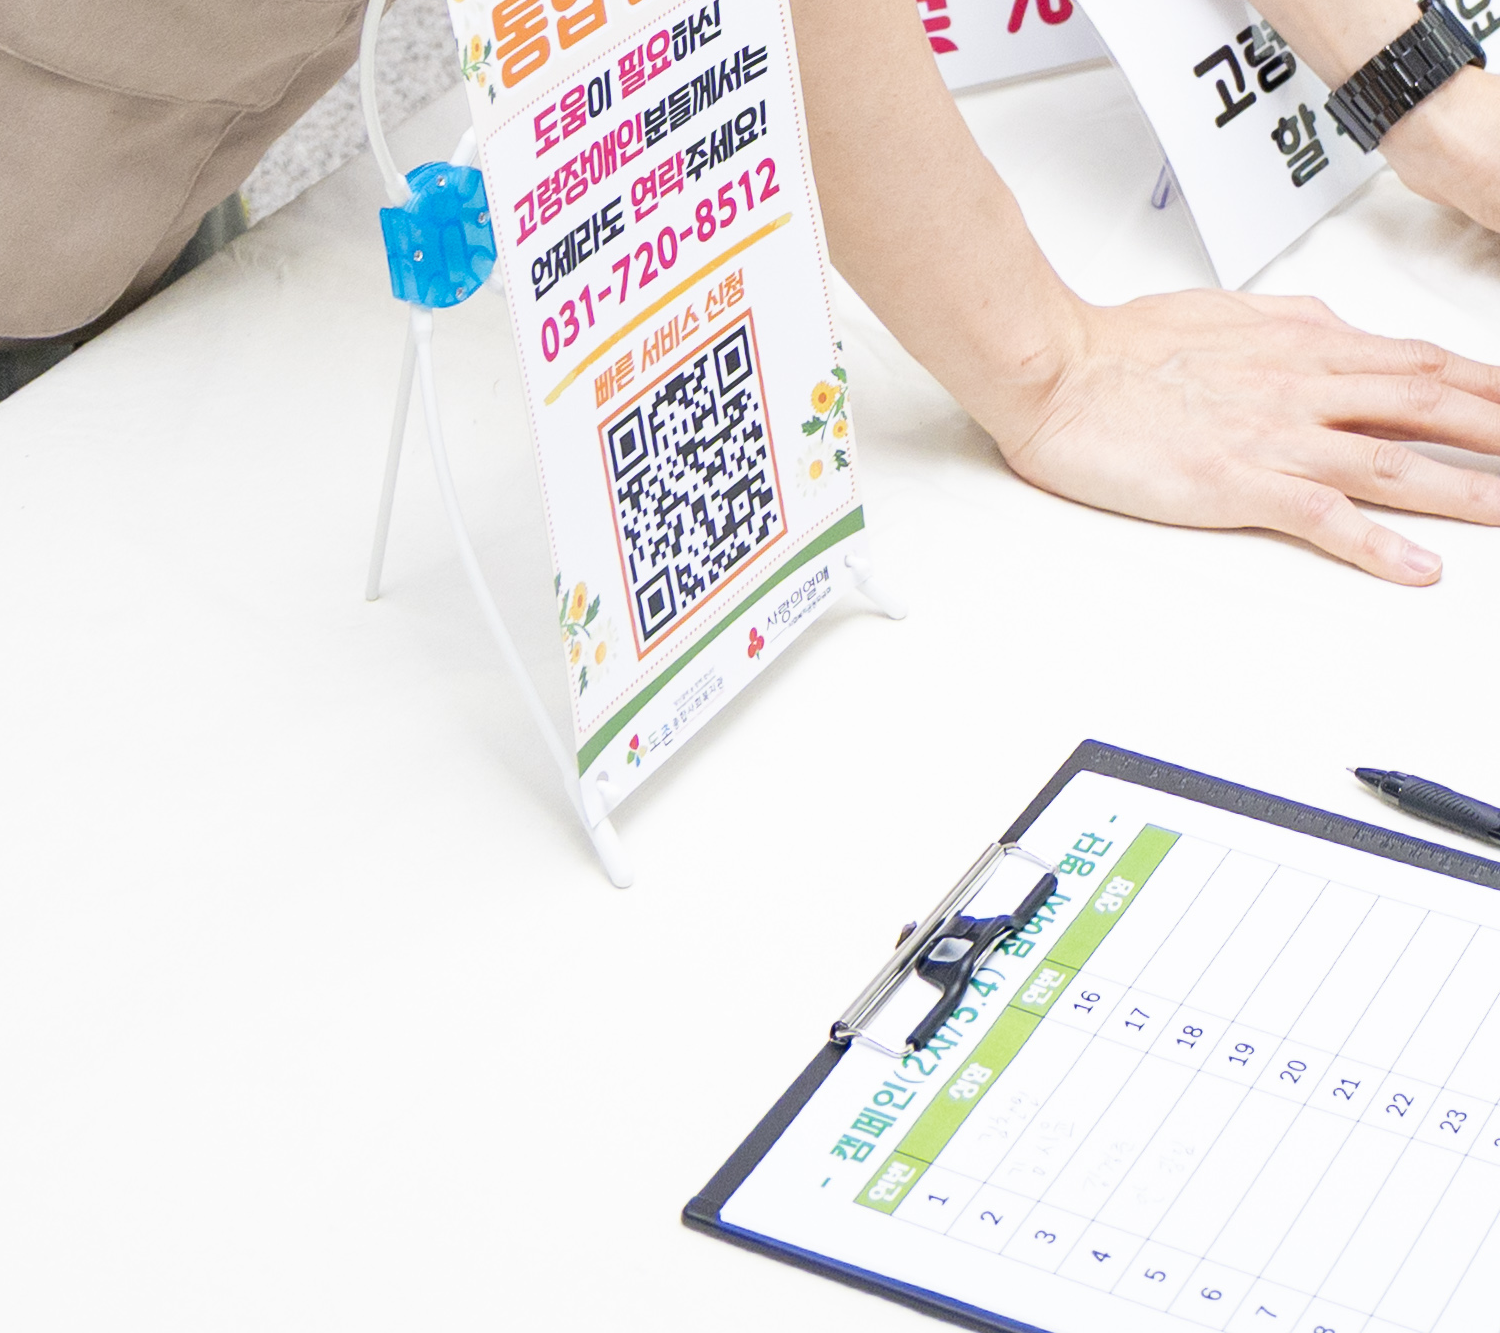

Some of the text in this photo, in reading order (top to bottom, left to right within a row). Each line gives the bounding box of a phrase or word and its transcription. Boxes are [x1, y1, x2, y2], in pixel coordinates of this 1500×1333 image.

[533, 69, 613, 159] 도움이
[513, 44, 769, 247] 고령장애인분들께서는
[530, 99, 768, 302] 언제라도 연락주세요!
[539, 157, 782, 364] 031-720-8512
[640, 307, 702, 376] 서비스
[704, 267, 746, 325] 신청
[766, 564, 830, 632] 사랑의열매
[1057, 831, 1114, 877] 명단
[1073, 990, 1101, 1014] 16
[1124, 1007, 1150, 1032] 17
[1176, 1025, 1204, 1049] 18
[1228, 1042, 1255, 1067] 19
[1279, 1060, 1308, 1084] 20
[1332, 1078, 1362, 1101] 21
[1385, 1093, 1415, 1118] 22
[1439, 1109, 1468, 1134] 23
[928, 1194, 949, 1206] 1
[980, 1210, 1003, 1226] 2
[1034, 1229, 1057, 1244] 3
[1091, 1249, 1112, 1263] 4
[1143, 1268, 1167, 1283] 5
[1200, 1287, 1223, 1301] 6
[1255, 1305, 1277, 1318] 7
